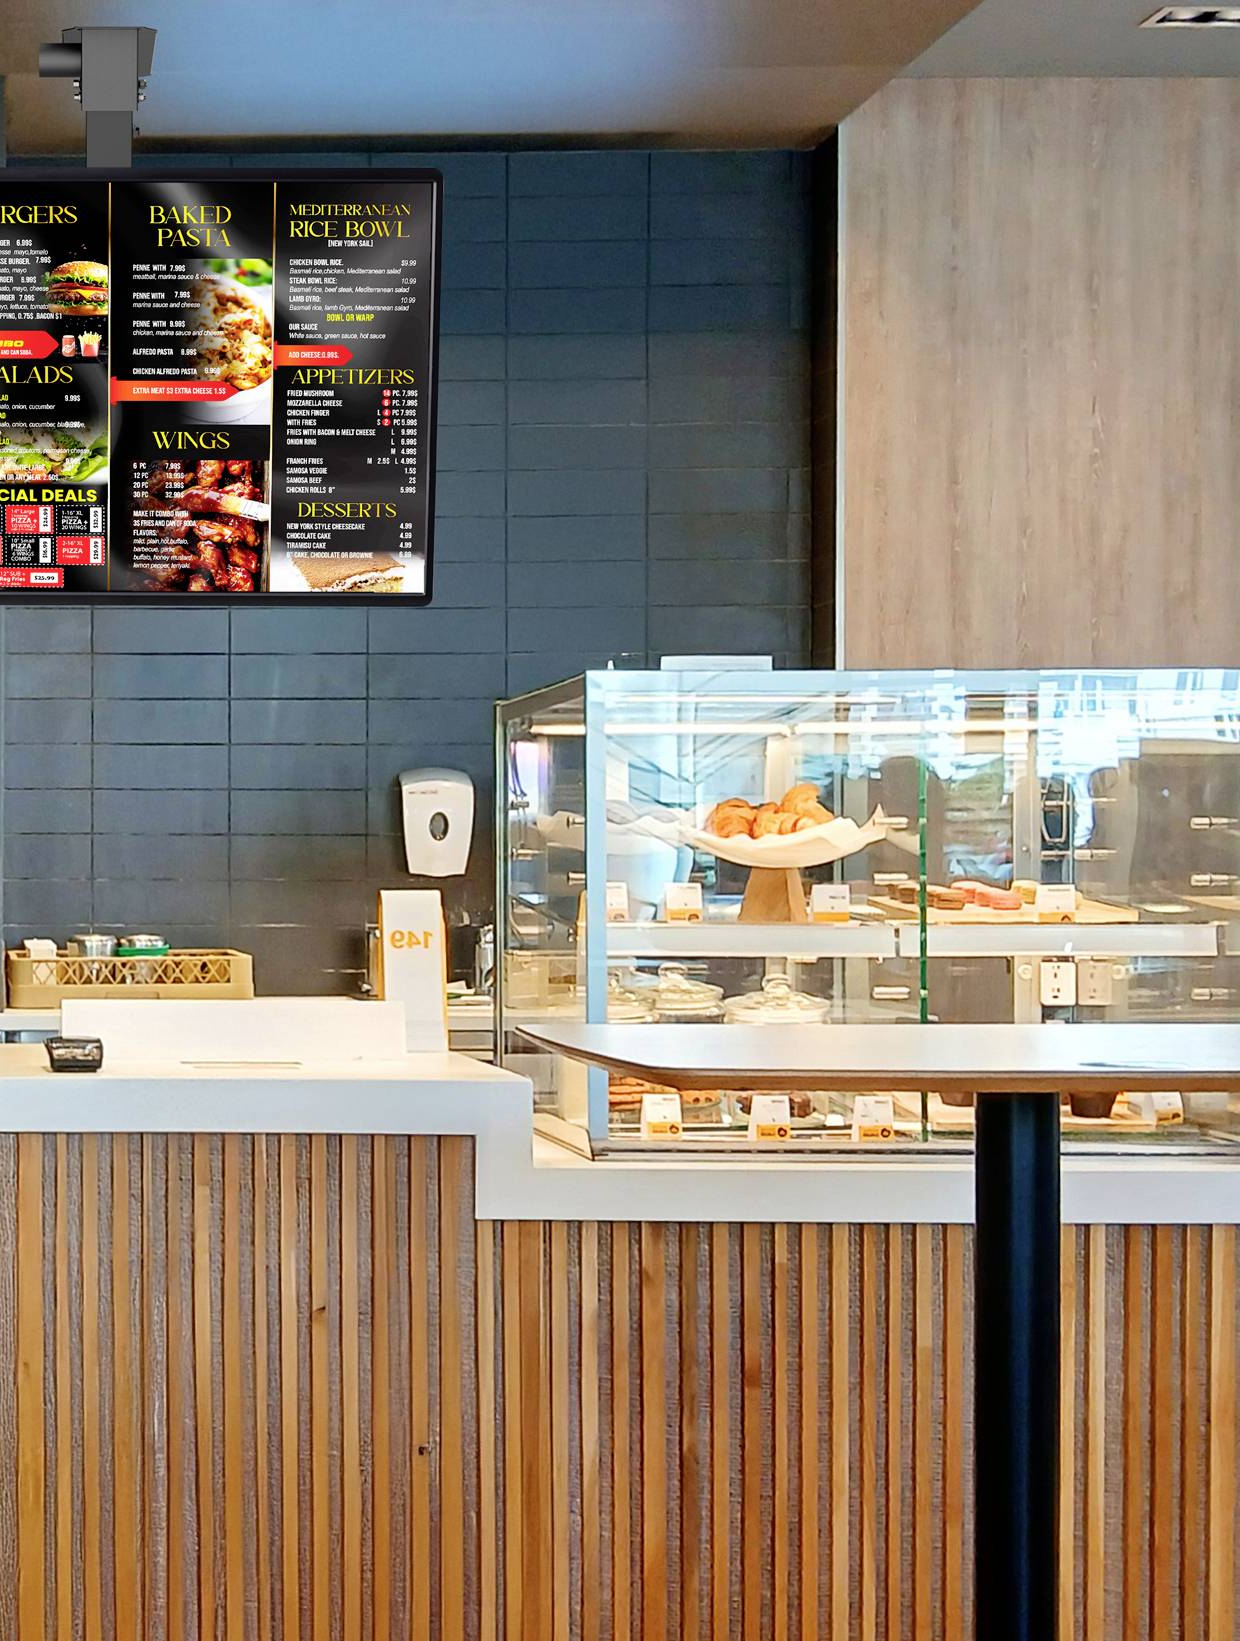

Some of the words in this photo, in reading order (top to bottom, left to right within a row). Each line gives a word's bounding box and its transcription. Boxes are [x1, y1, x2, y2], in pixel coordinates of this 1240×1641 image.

[150, 206, 232, 224] BAKED
[290, 205, 410, 216] MEDITERRANEAN
[290, 221, 338, 237] RICE
[346, 221, 410, 237] BOWL
[157, 228, 232, 247] PASTA
[292, 369, 415, 384] APPETIZERS
[152, 432, 230, 449] WINGS
[42, 489, 97, 502] DEALS
[298, 502, 397, 517] DESSERTS
